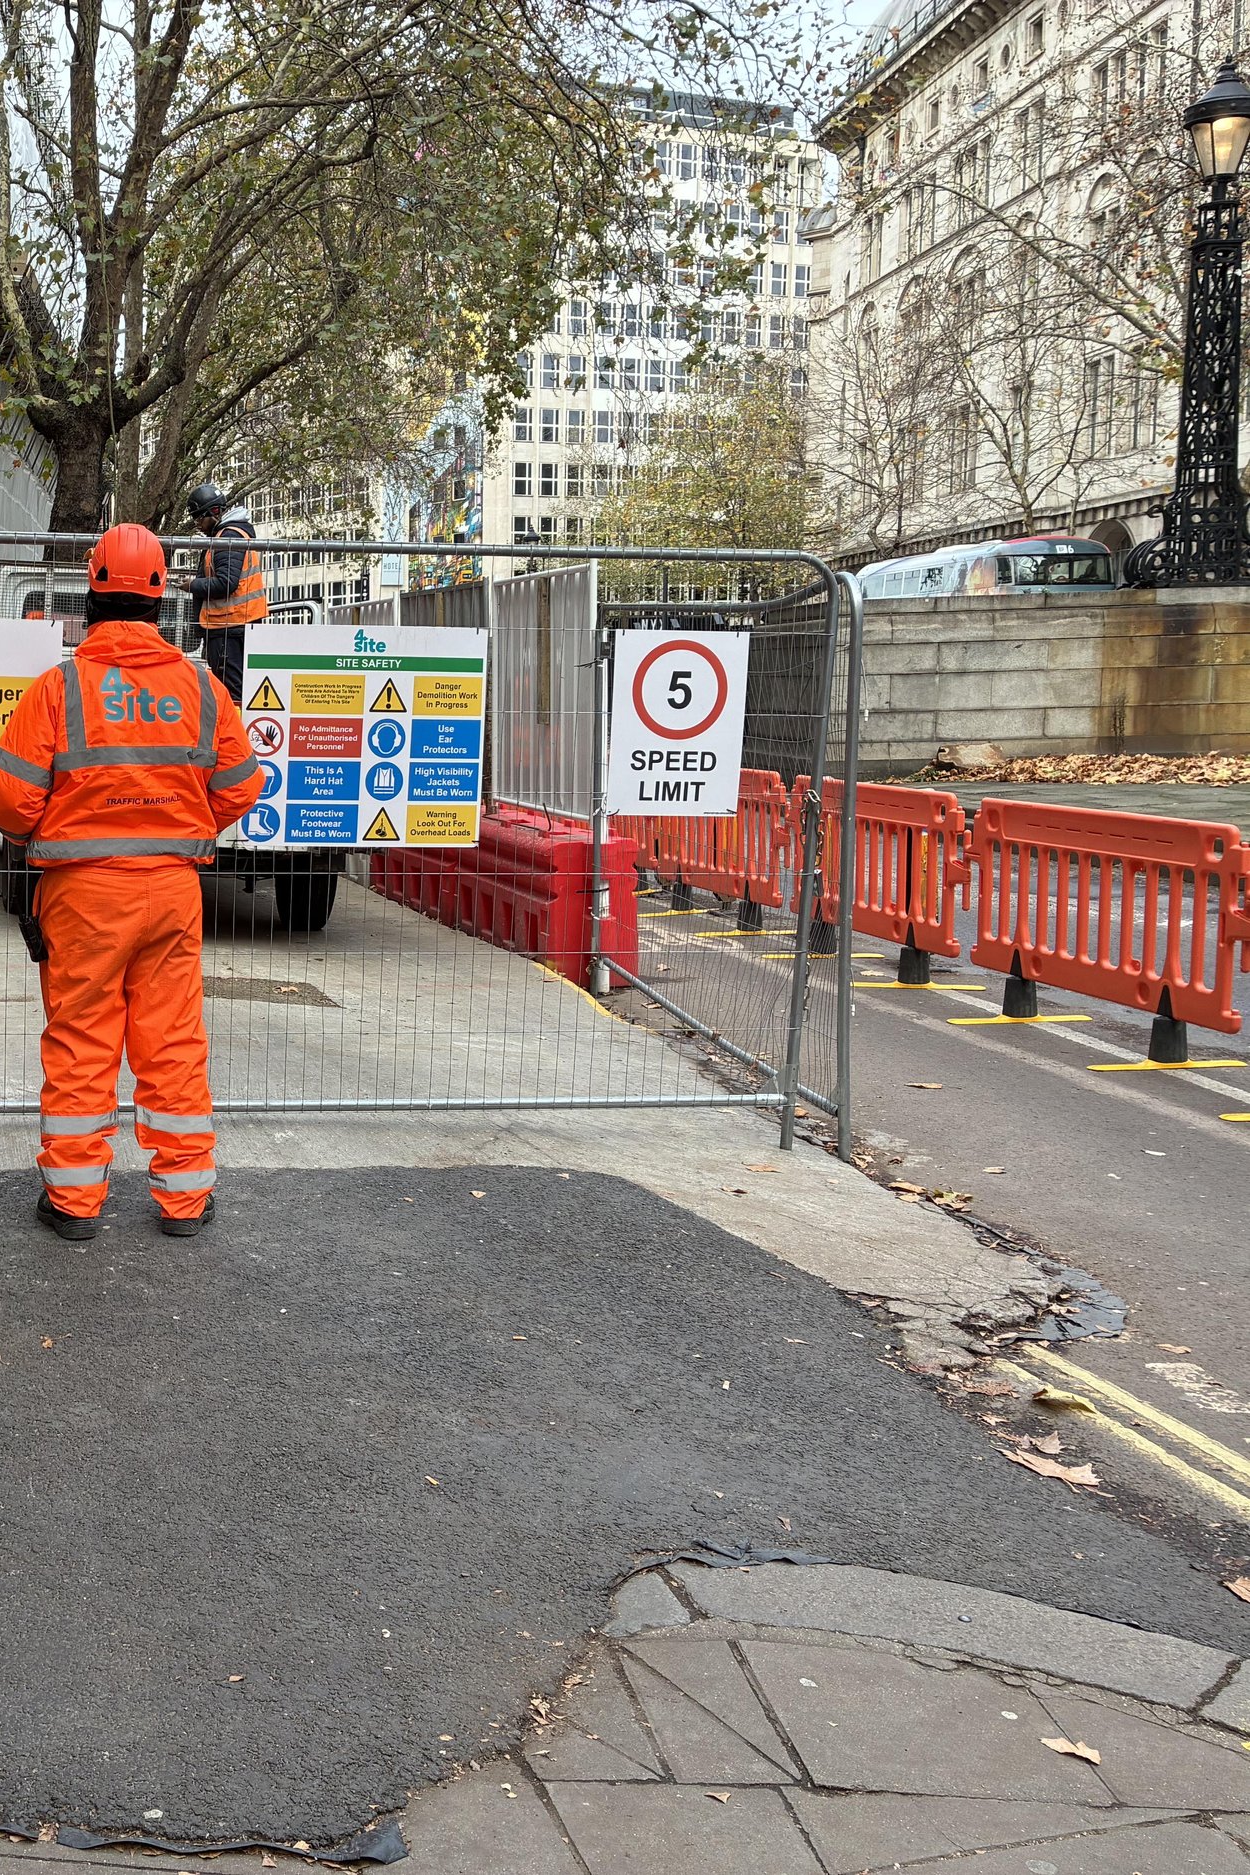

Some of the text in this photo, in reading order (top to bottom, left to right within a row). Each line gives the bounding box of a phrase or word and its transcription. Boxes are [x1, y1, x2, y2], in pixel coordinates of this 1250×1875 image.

[336, 659, 402, 668] SITE SAFETY
[435, 683, 462, 691] Danger
[667, 671, 692, 710] 5
[435, 701, 468, 710] Progress
[312, 725, 353, 733] Admittance
[438, 725, 454, 733] Use
[439, 735, 453, 743] Ear
[423, 746, 467, 754] Protectors
[630, 750, 717, 771] SPEED
[305, 766, 343, 774] This Is A
[414, 768, 473, 777] High Visibility
[304, 776, 343, 785] Hard Hat
[427, 778, 460, 786] Jackets
[312, 787, 334, 796] Area
[639, 781, 706, 802] LIMIT
[300, 809, 344, 818] Protective
[426, 811, 457, 819] Warning
[291, 830, 351, 838] Must Be Worn
